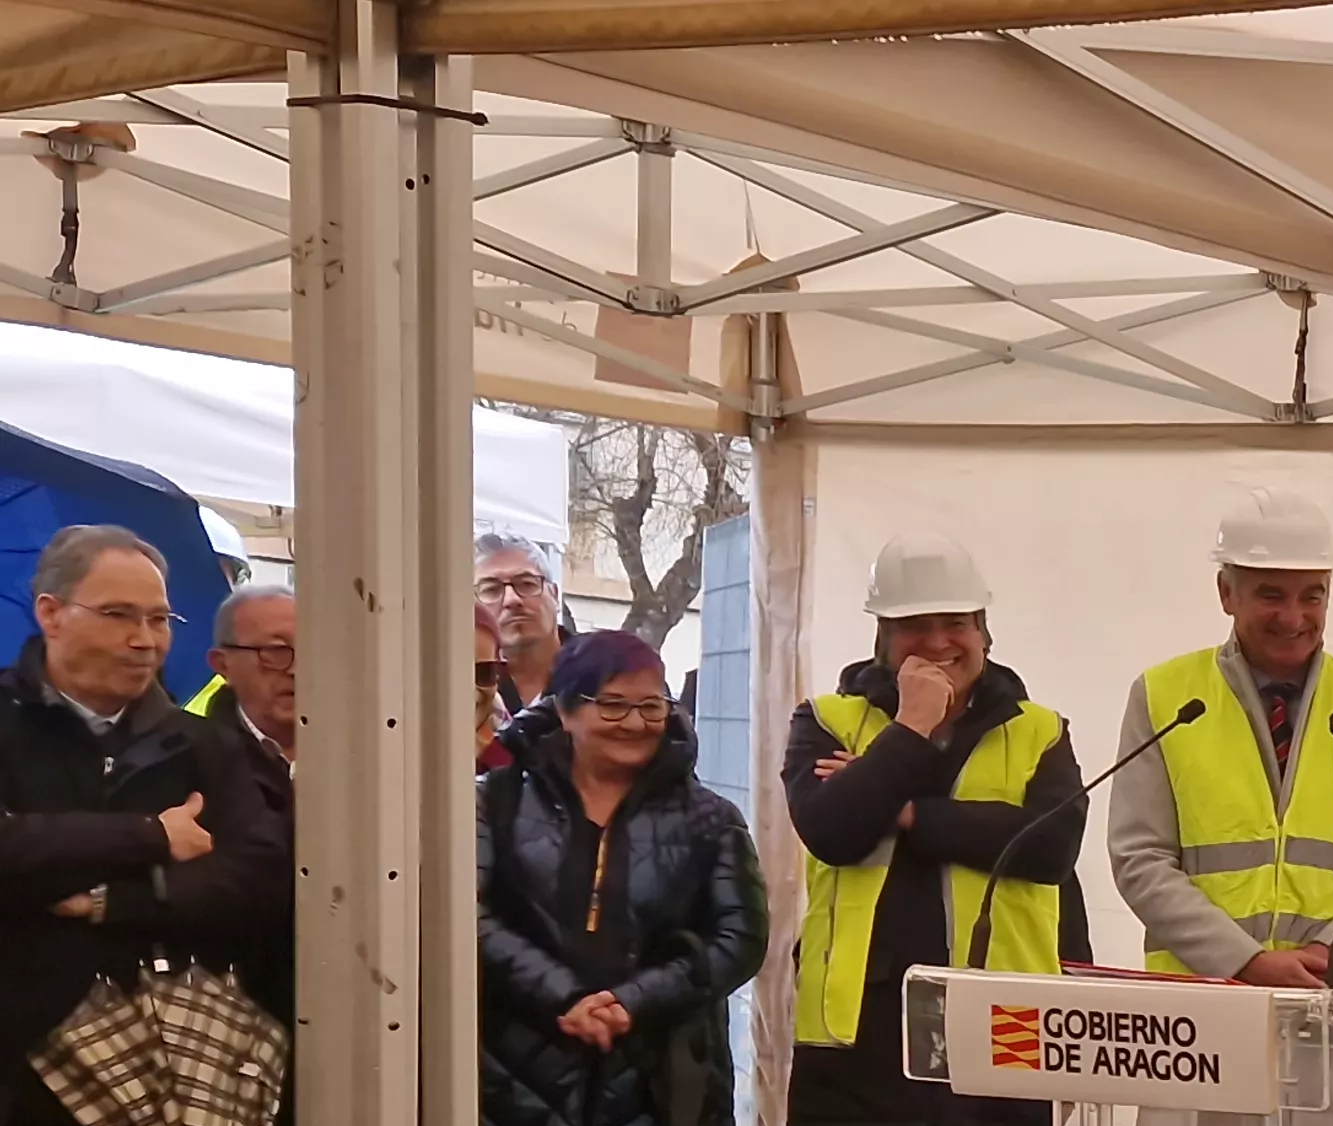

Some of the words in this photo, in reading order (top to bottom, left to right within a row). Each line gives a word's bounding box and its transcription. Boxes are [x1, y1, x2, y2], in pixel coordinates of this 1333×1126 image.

[1043, 1008, 1197, 1048] GOBIERNO
[1044, 1041, 1082, 1074] DE
[1092, 1046, 1221, 1085] ARAGON
